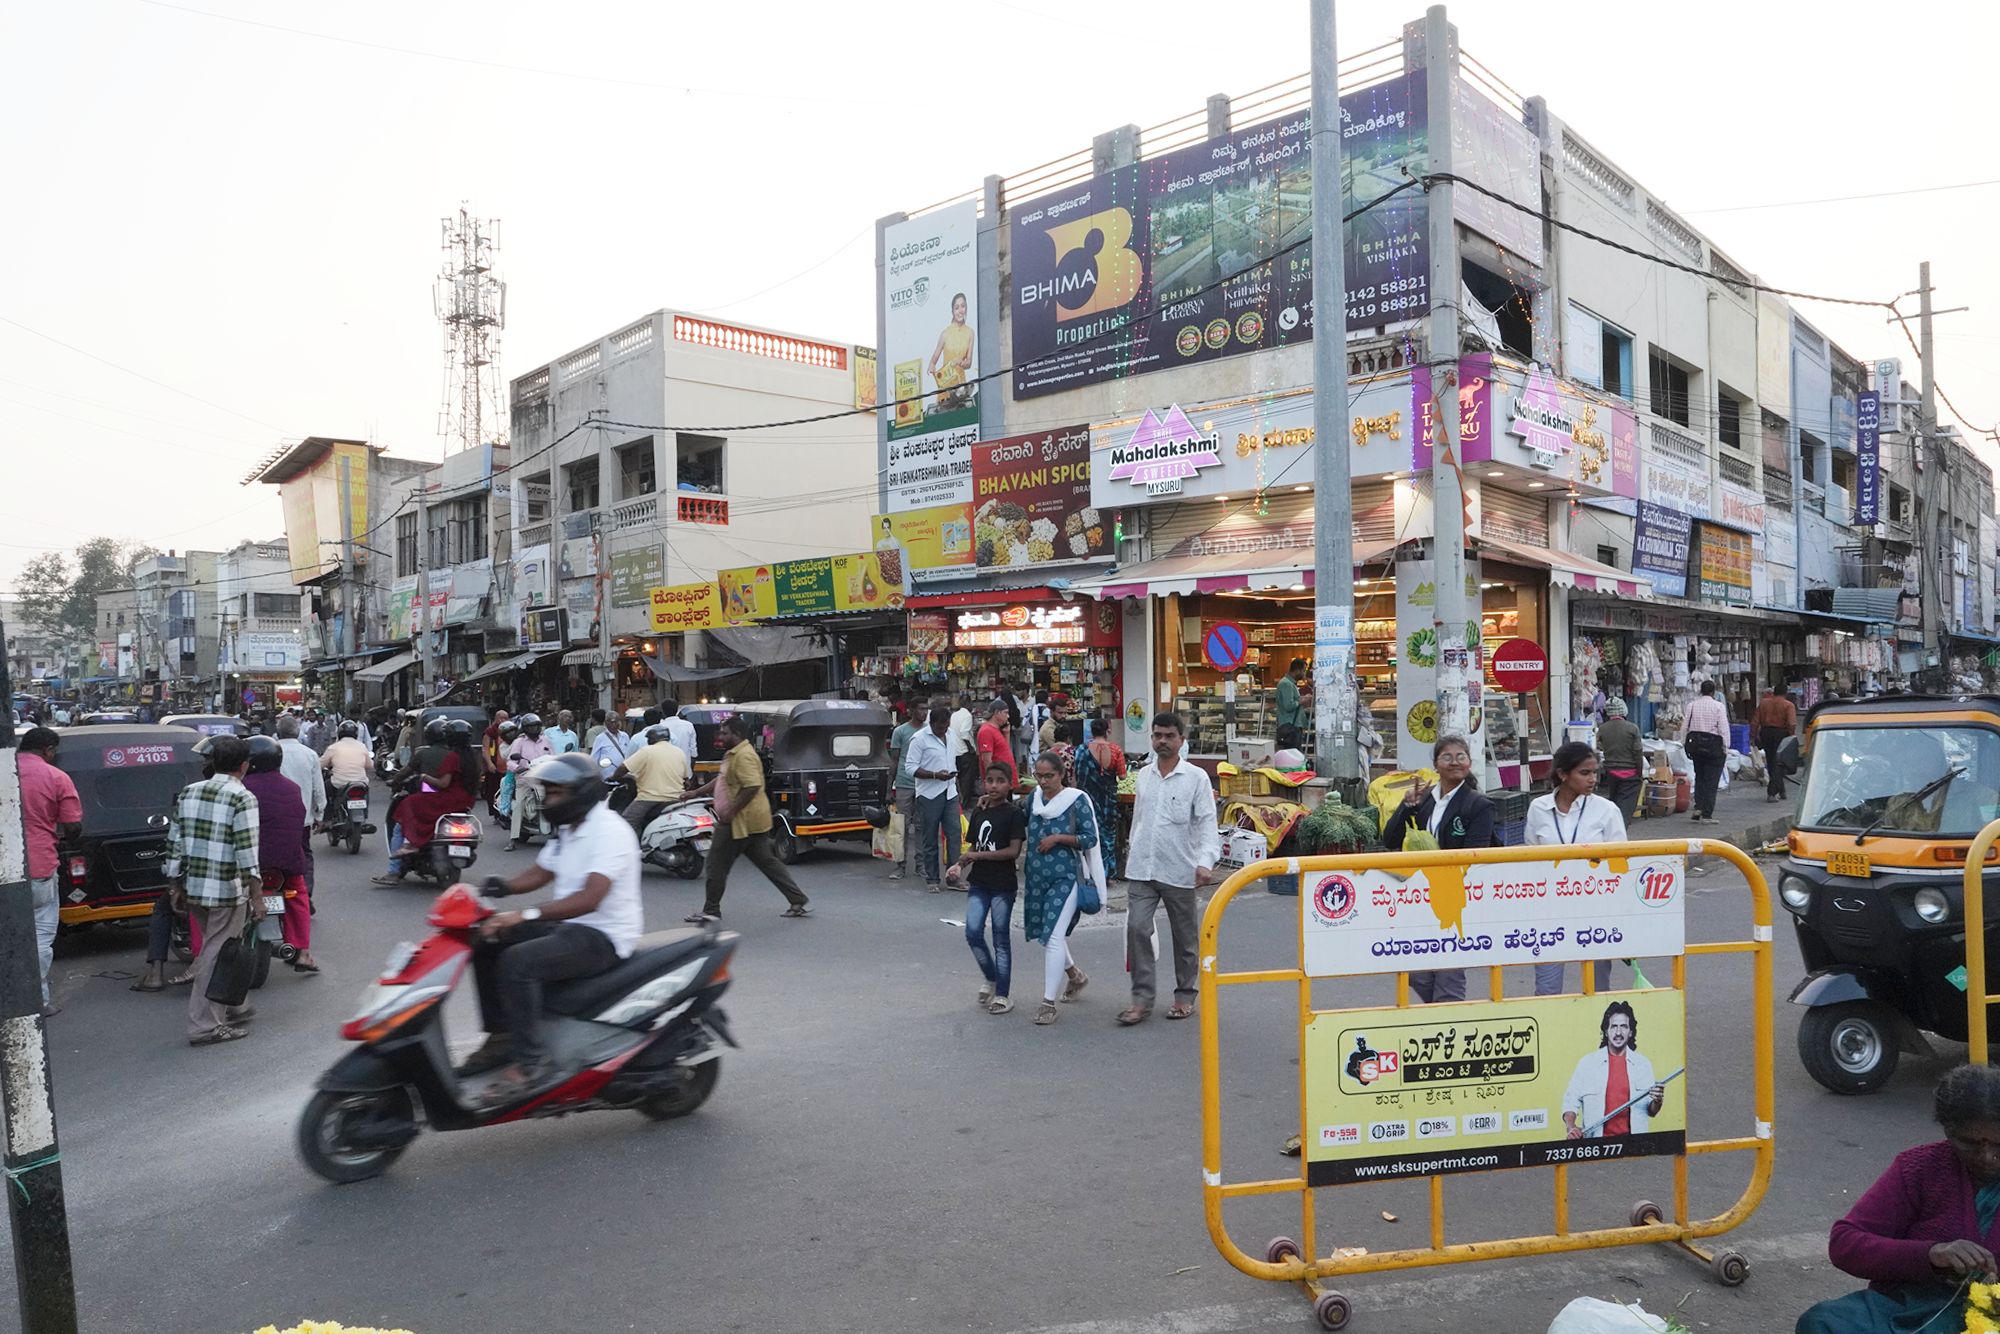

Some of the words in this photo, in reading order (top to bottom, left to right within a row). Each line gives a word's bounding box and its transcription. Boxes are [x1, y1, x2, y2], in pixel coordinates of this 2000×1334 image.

[1362, 231, 1421, 253] BHIMA
[1366, 245, 1418, 264] VISHAKA
[1021, 268, 1097, 305] BHIMA
[1221, 268, 1272, 287] BHIMA
[1381, 275, 1427, 295] 58821
[891, 288, 913, 302] VITO
[1161, 285, 1204, 302] BHIMA
[1381, 293, 1427, 312] 88821
[1229, 300, 1243, 309] Hill
[1056, 315, 1125, 345] Properties
[1514, 398, 1573, 434] Mahalakshmi
[991, 441, 1034, 465] ಭವಾನಿ
[1111, 434, 1219, 466] Mahalakshmi
[888, 473, 899, 486] SRI
[900, 464, 949, 485] VENKATESHWARA
[980, 468, 1047, 495] BHAVANI
[1143, 463, 1188, 481] SWEETS
[1148, 479, 1181, 494] MYSURU
[834, 558, 848, 566] KOF
[137, 752, 168, 763] 4103
[1835, 853, 1864, 865] KA09A
[1492, 879, 1547, 900] ಸಂಚಾರ
[1555, 875, 1622, 897] ಪೊಲೀಸ್
[1643, 872, 1674, 900] 112
[1371, 932, 1492, 957] ಯಾವಾಗಲೂ
[1503, 926, 1566, 959] ಹೆಲ್ಮೆಟ್
[1576, 926, 1624, 946] ಧರಿಸಿ
[1461, 1025, 1535, 1060] ಸೂಪರ್
[1360, 1054, 1396, 1080] SK
[1481, 1061, 1514, 1082] ಸ್ಟೀಲ್
[1386, 1123, 1405, 1131] XTRA
[1432, 1121, 1449, 1131] 18%
[1474, 1117, 1490, 1128] EQR
[1386, 1129, 1405, 1137] GRIP
[1545, 1147, 1573, 1162] 7337
[1575, 1145, 1600, 1160] 666
[1602, 1143, 1623, 1158] 777
[1354, 1153, 1499, 1178] www.sksupertmt.com
